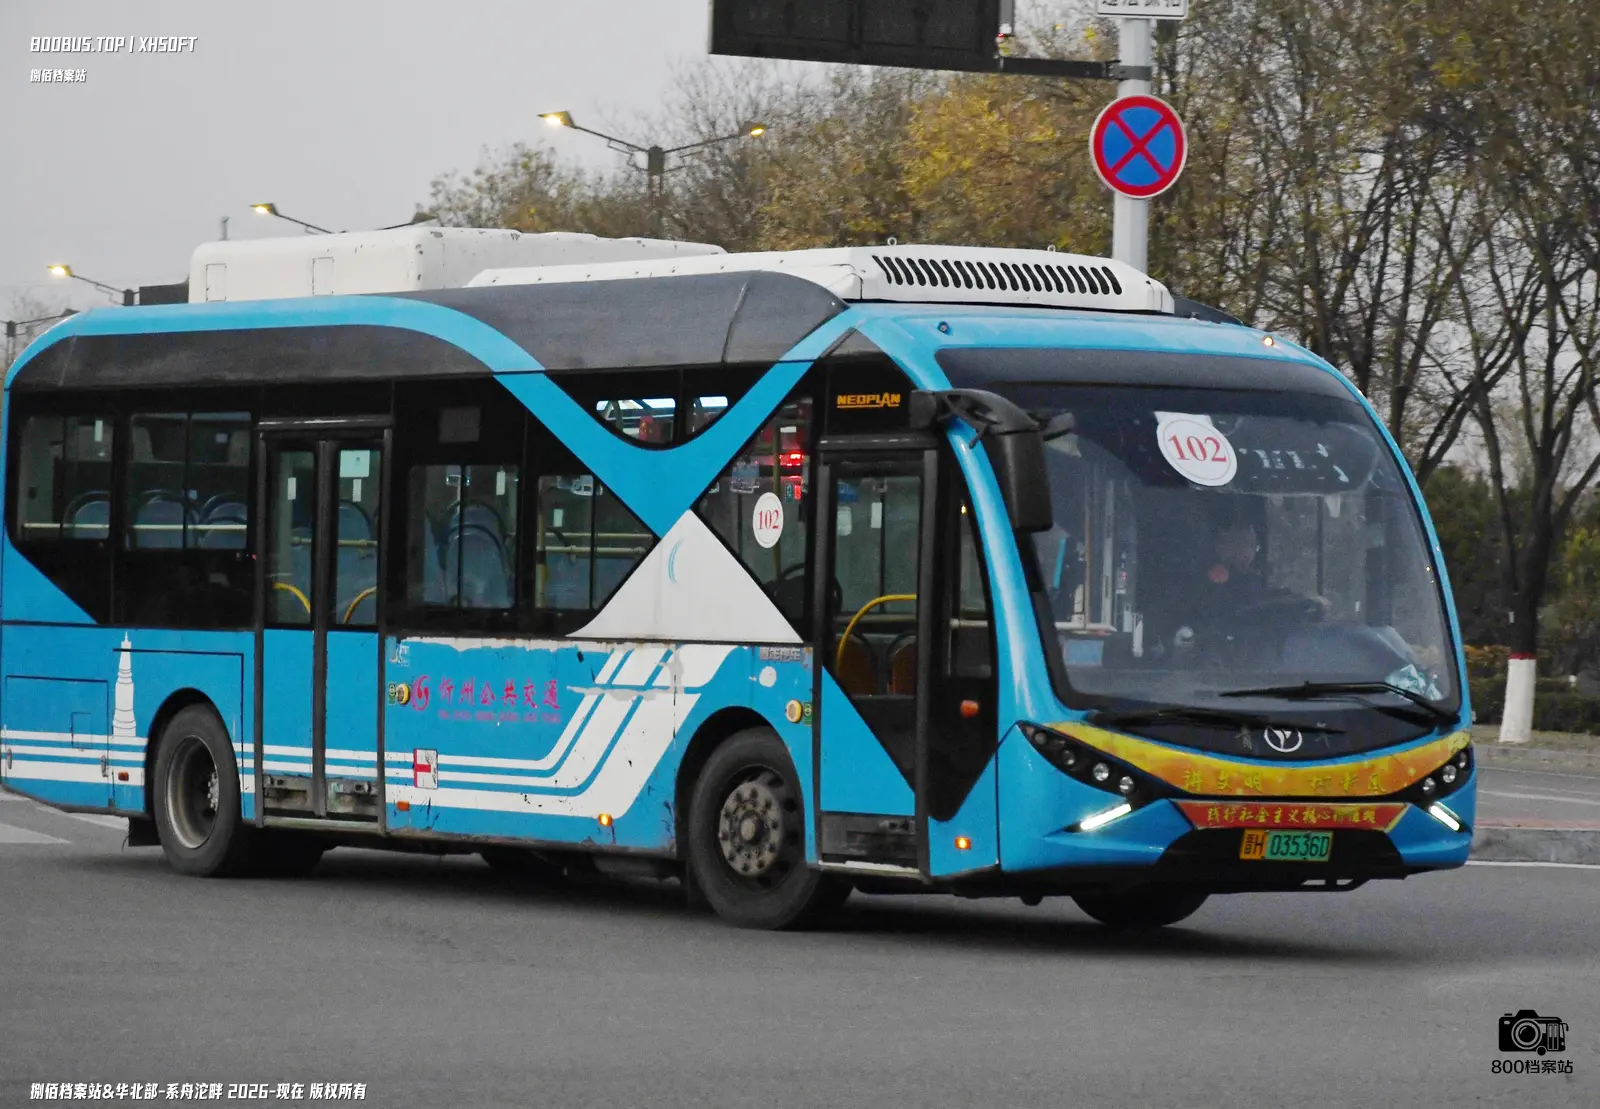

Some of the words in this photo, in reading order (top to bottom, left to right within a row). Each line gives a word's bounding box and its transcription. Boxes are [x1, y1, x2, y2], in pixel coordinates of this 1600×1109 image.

[837, 392, 901, 408] NEOPLAN
[1168, 435, 1227, 463] 102
[758, 510, 780, 530] 102
[439, 676, 560, 709] 忻州公共交通
